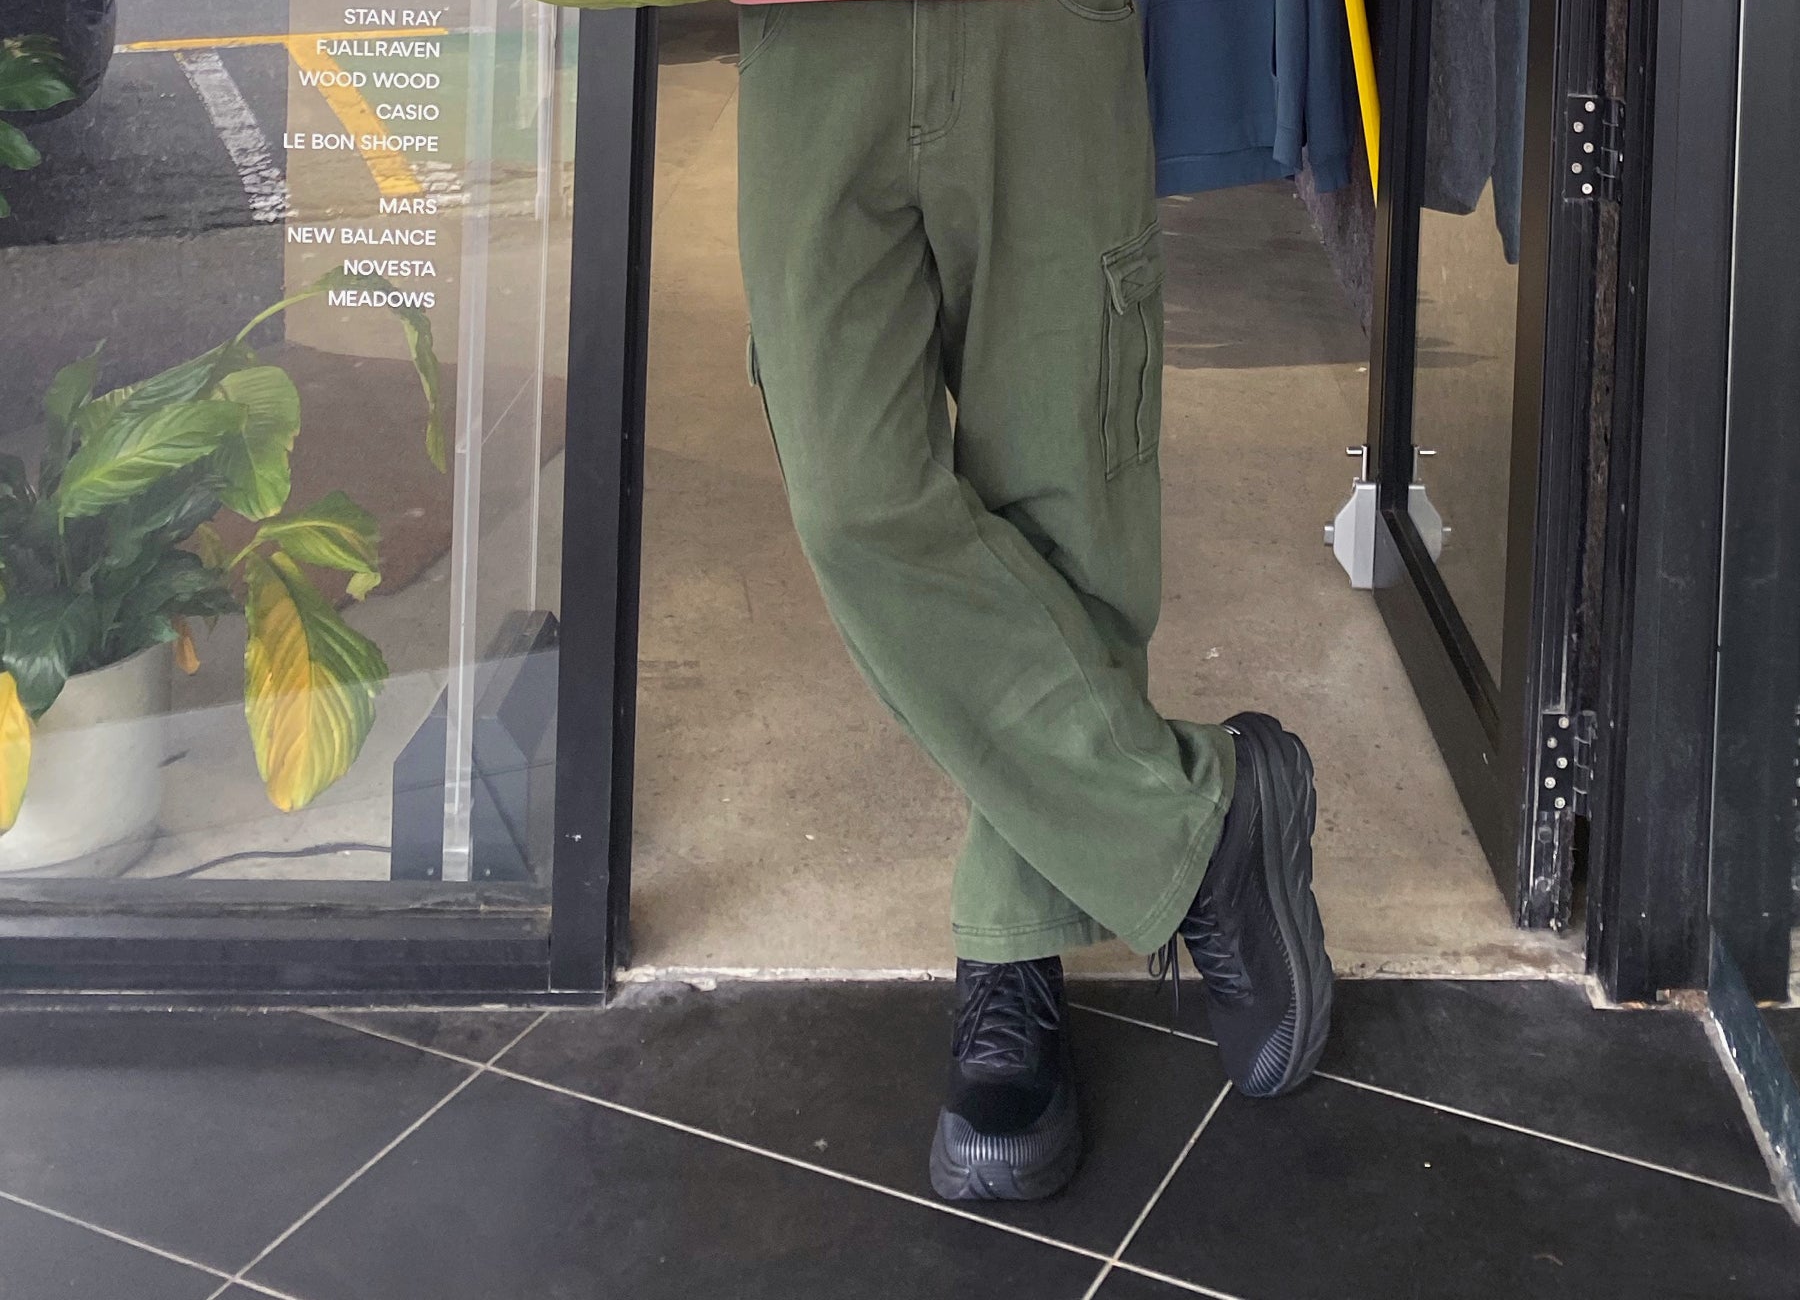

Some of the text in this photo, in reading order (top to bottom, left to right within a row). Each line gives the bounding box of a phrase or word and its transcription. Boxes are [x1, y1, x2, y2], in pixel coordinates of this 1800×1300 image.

[344, 9, 442, 26] STAN RAY
[316, 39, 440, 58] FJALLRAVEN
[299, 70, 440, 89] WOOD WOOD
[376, 103, 439, 120] CASIO
[283, 133, 439, 152] LE BON SHOPPE
[379, 198, 437, 215] MARS
[287, 227, 437, 246] NEW BALANCE
[343, 259, 436, 277] NOVESTA
[328, 290, 435, 308] MEADOWS
